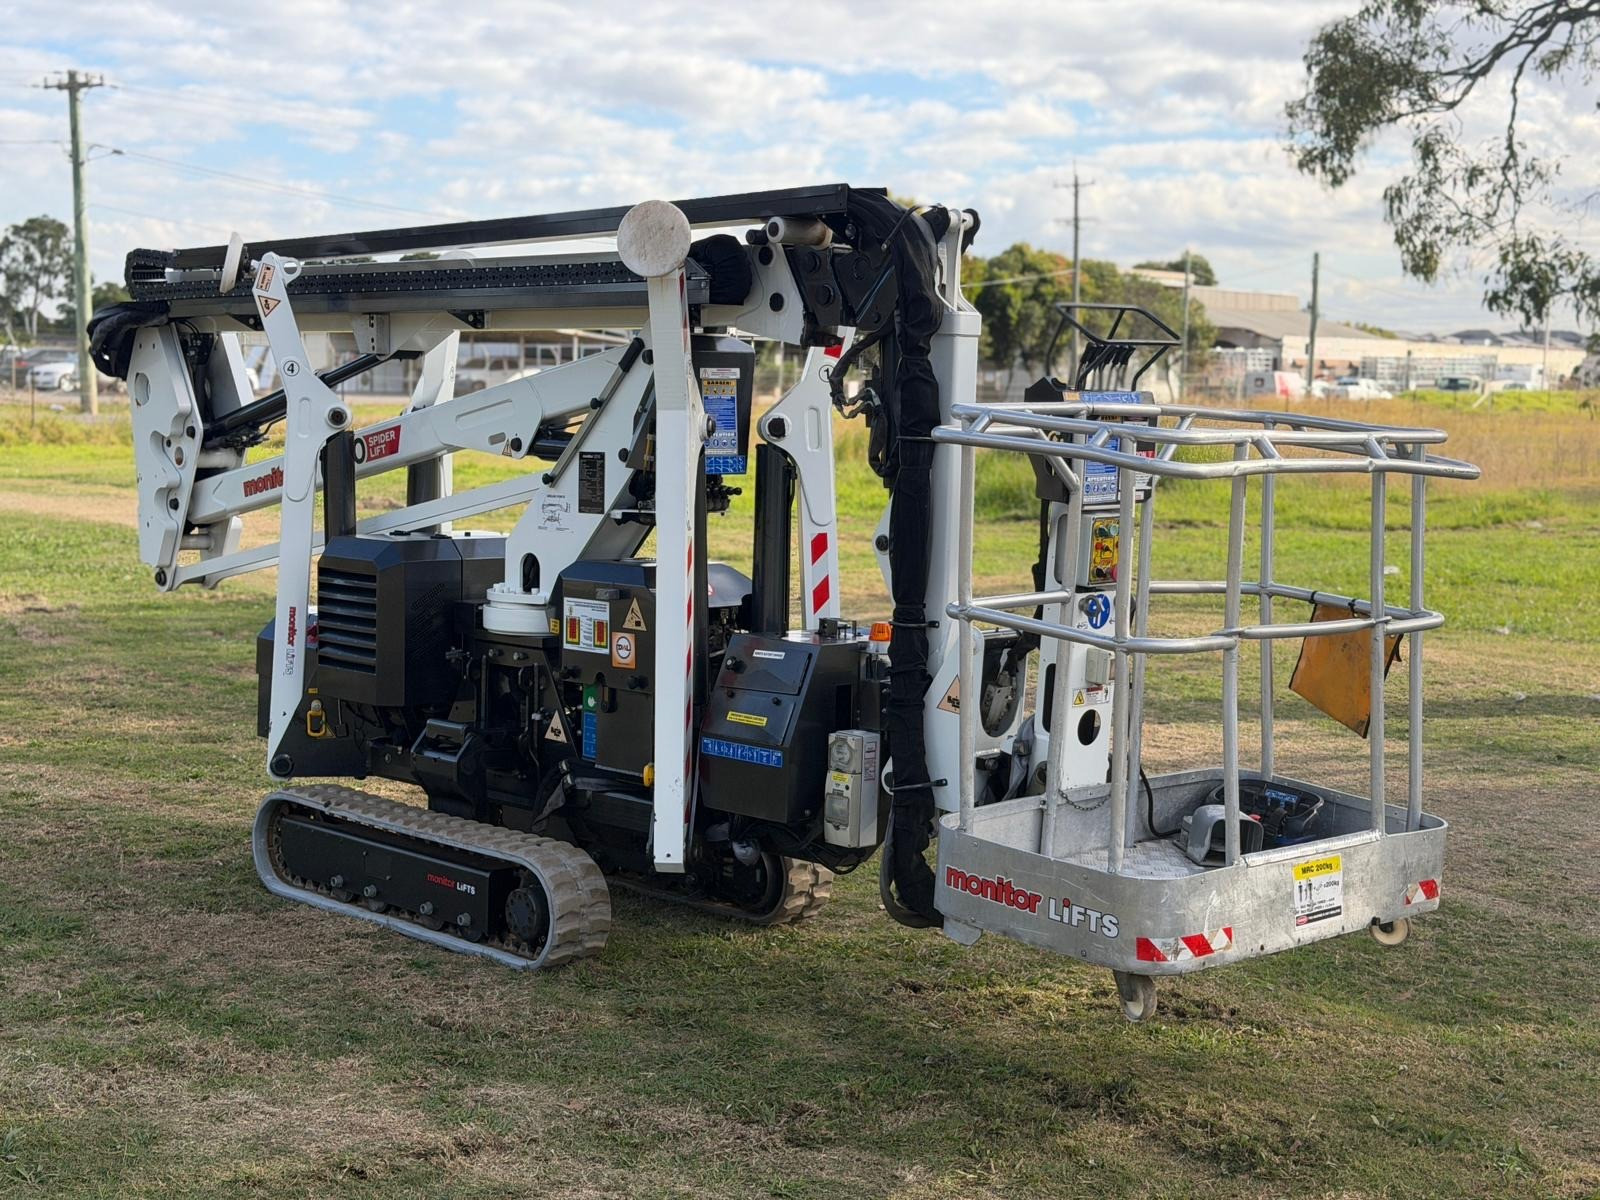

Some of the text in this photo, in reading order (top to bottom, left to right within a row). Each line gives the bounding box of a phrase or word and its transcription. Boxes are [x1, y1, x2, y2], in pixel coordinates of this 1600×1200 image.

[368, 430, 396, 447] SPIDER
[369, 444, 386, 458] LIFT
[243, 465, 284, 497] monit
[287, 606, 297, 647] monitor
[1301, 862, 1333, 875] MRC 200kg
[427, 873, 455, 889] monitor
[946, 865, 1042, 914] monitor
